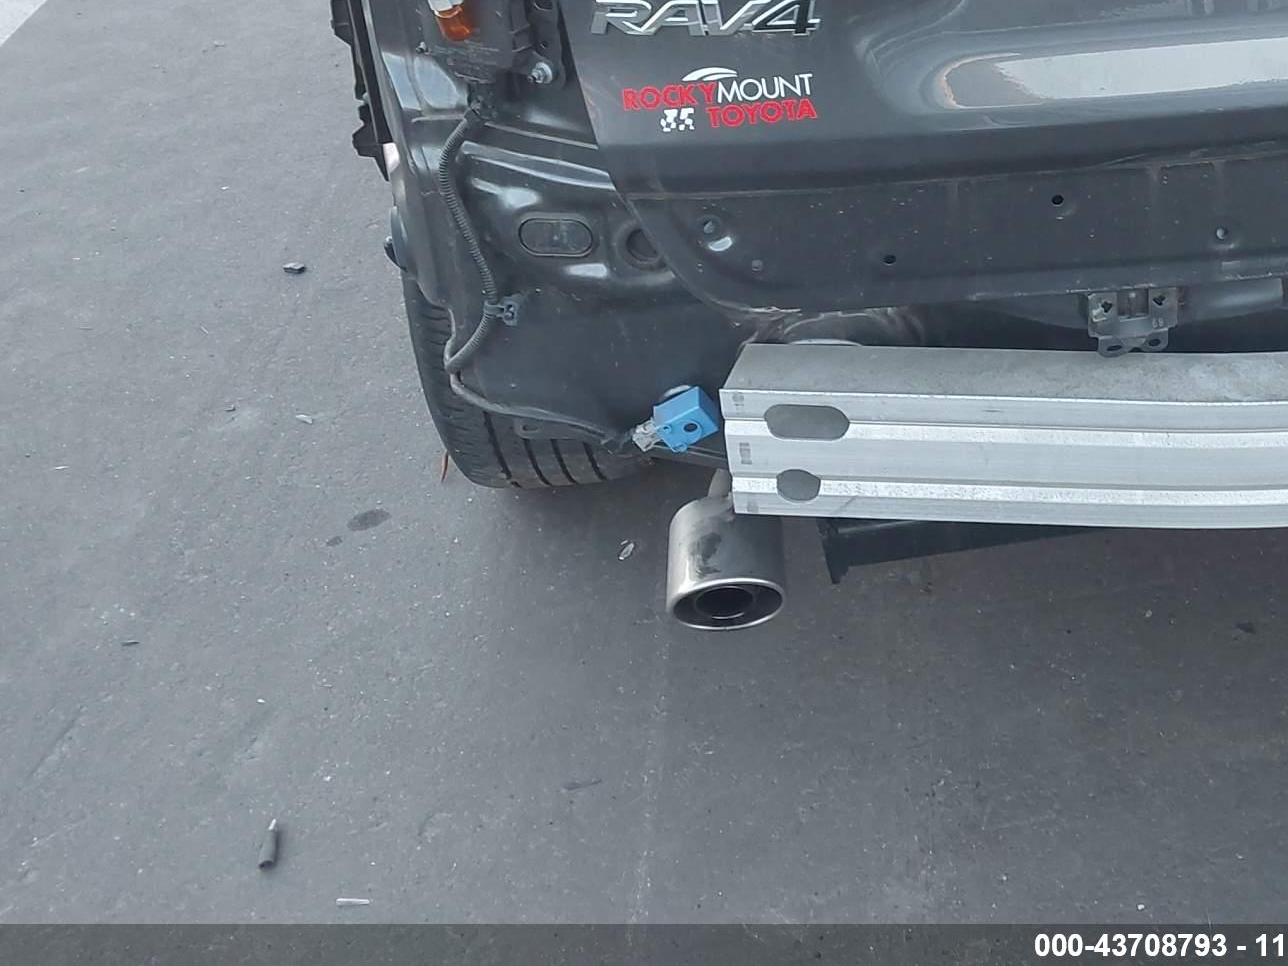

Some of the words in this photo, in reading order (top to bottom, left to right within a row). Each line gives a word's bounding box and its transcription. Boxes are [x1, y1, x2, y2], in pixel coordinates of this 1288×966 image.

[622, 81, 716, 112] ROCKY
[717, 73, 813, 103] MOUNT
[706, 98, 818, 129] TOYOTA
